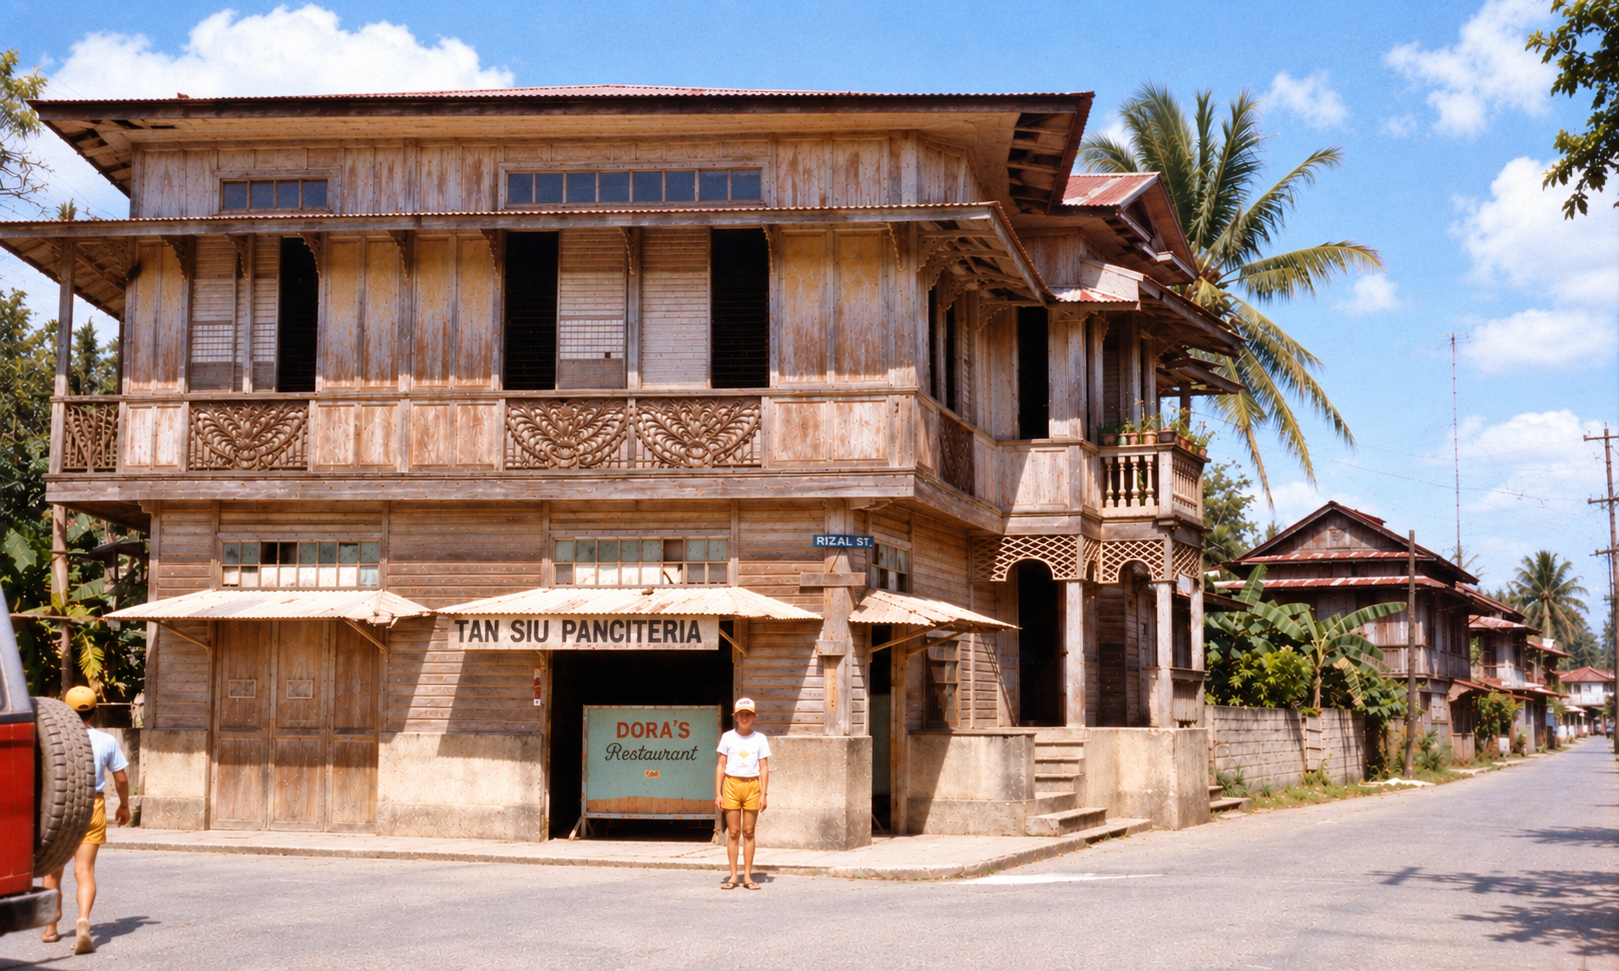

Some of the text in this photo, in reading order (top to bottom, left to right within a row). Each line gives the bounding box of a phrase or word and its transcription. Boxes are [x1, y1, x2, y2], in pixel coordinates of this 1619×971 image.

[816, 536, 873, 547] RIZAL ST.
[454, 619, 702, 644] TAN SIU PANCITERIA
[616, 720, 690, 739] DORA'S
[605, 742, 699, 761] Restaurant
